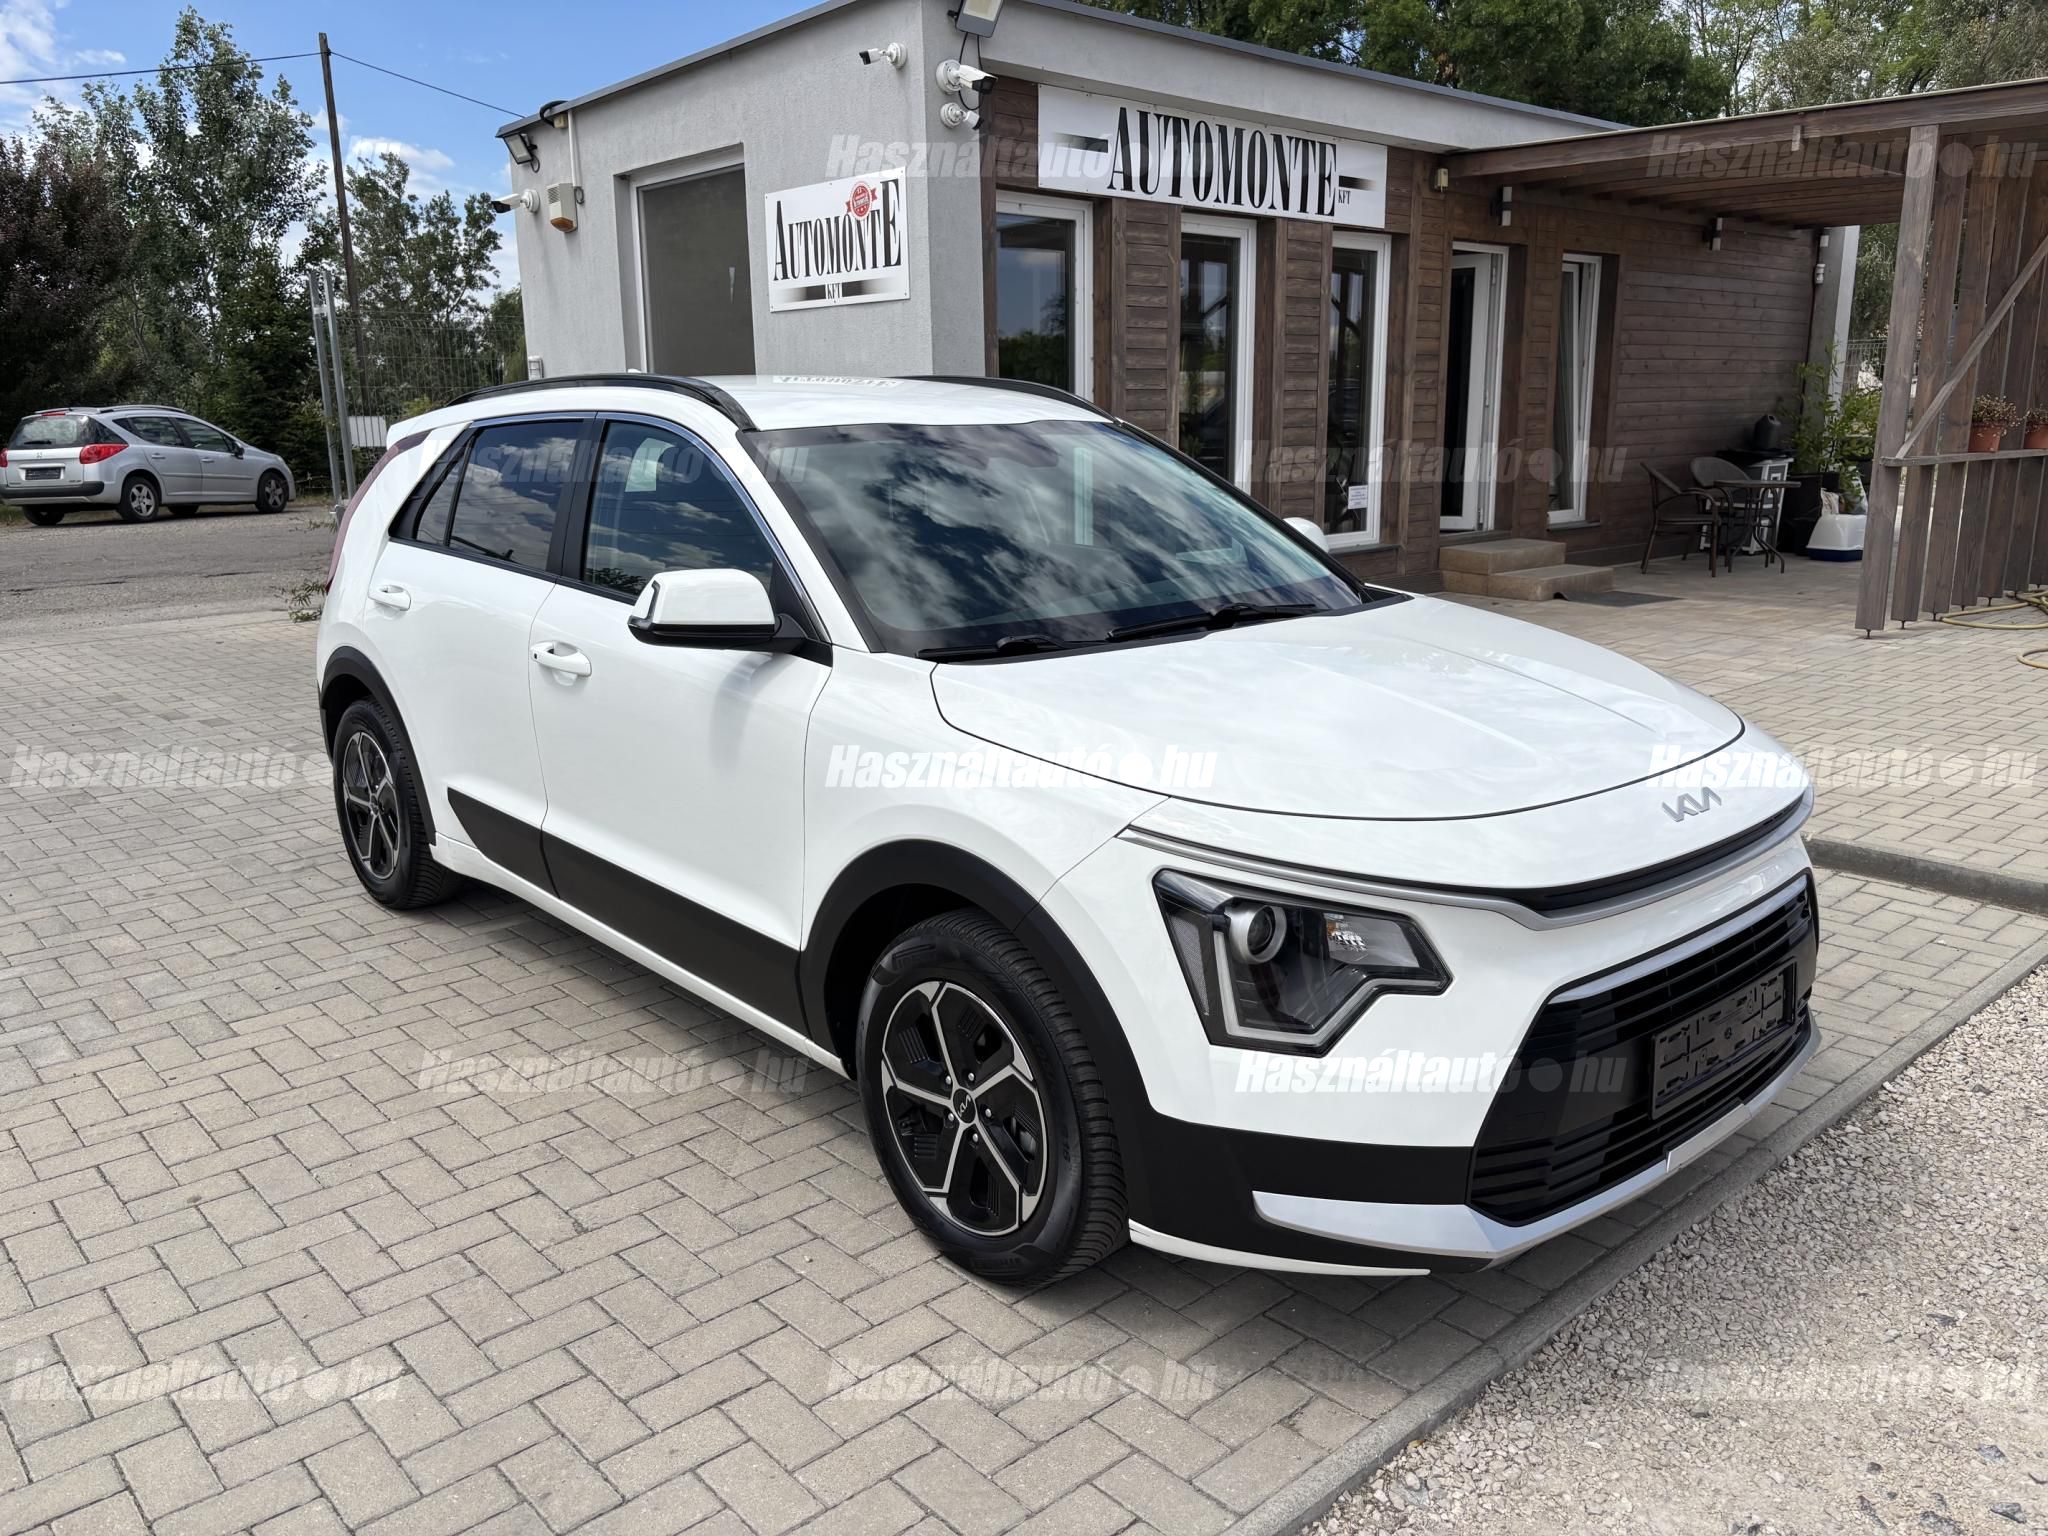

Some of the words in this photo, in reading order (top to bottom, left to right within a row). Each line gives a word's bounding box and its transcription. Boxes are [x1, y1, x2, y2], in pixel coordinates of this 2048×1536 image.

[1107, 106, 1336, 216] AUTOMONTE
[1337, 190, 1351, 205] KFT
[773, 178, 901, 281] AUTOMONTE
[827, 282, 841, 300] KFT
